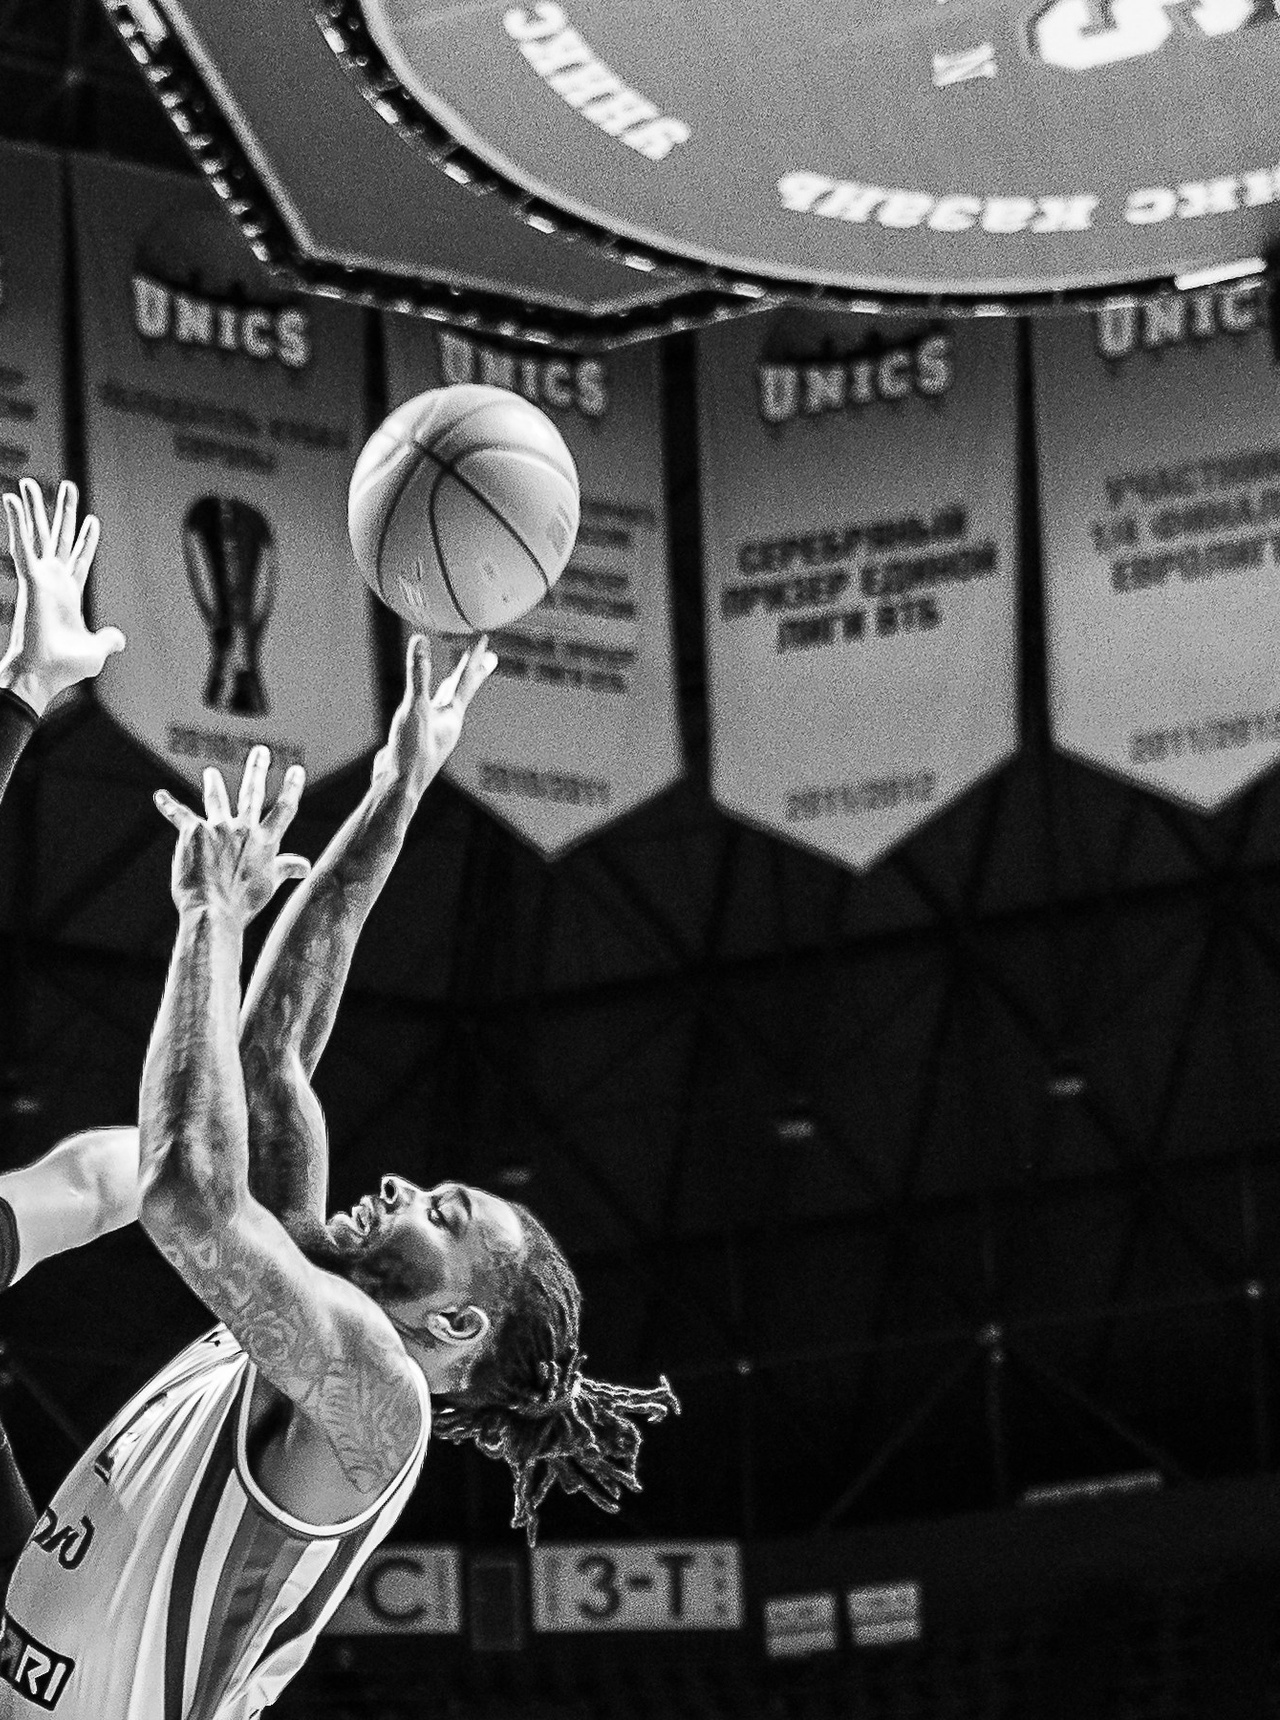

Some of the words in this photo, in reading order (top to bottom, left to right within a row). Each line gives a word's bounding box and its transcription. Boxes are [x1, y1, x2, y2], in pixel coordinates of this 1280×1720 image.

[131, 275, 311, 367] UNICS
[439, 331, 609, 415] UNICS
[760, 336, 953, 421] UNICS
